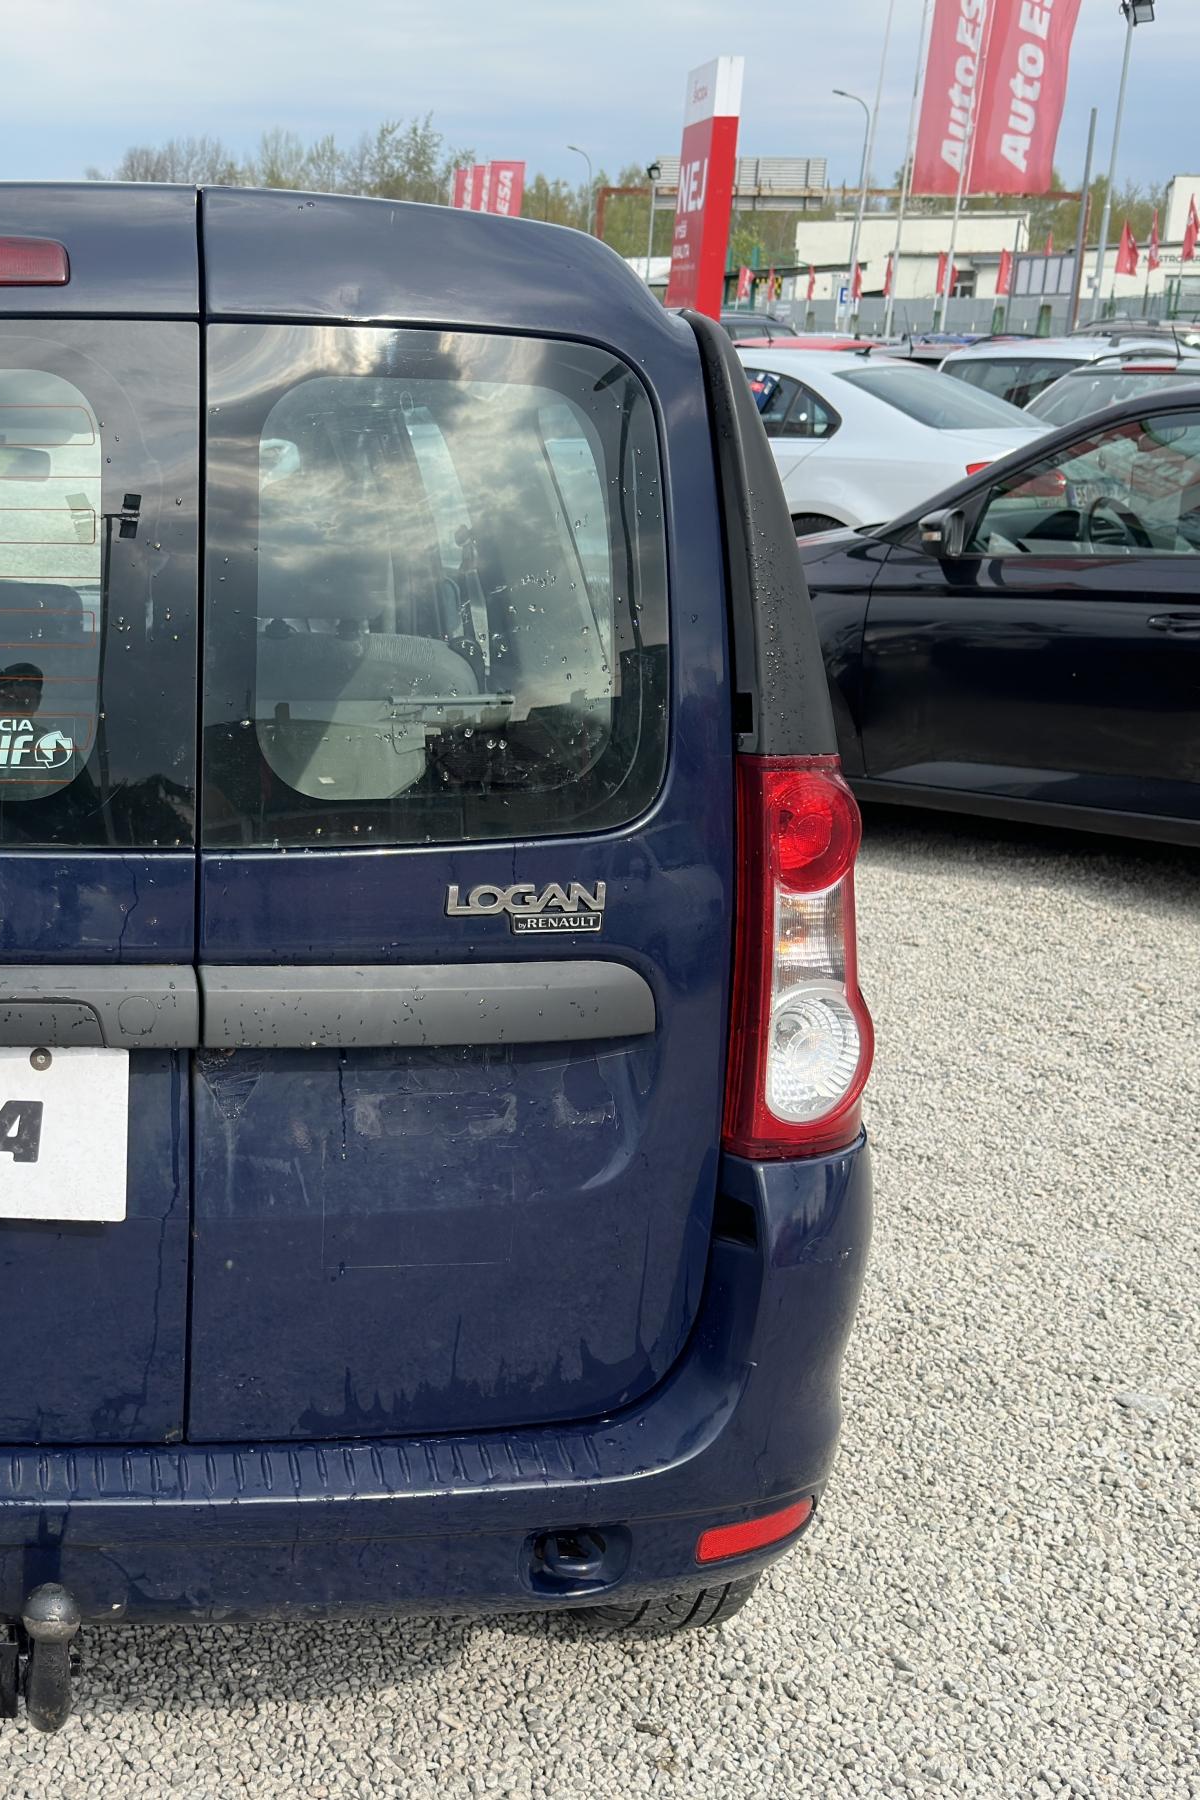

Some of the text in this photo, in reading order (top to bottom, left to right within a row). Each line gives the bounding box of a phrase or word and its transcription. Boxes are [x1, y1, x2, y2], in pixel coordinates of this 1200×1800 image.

[941, 55, 976, 175] Auto
[1000, 43, 1045, 173] Auto
[676, 157, 709, 215] NEJ
[446, 881, 607, 916] LOGAN
[518, 916, 597, 930] by RENAULT
